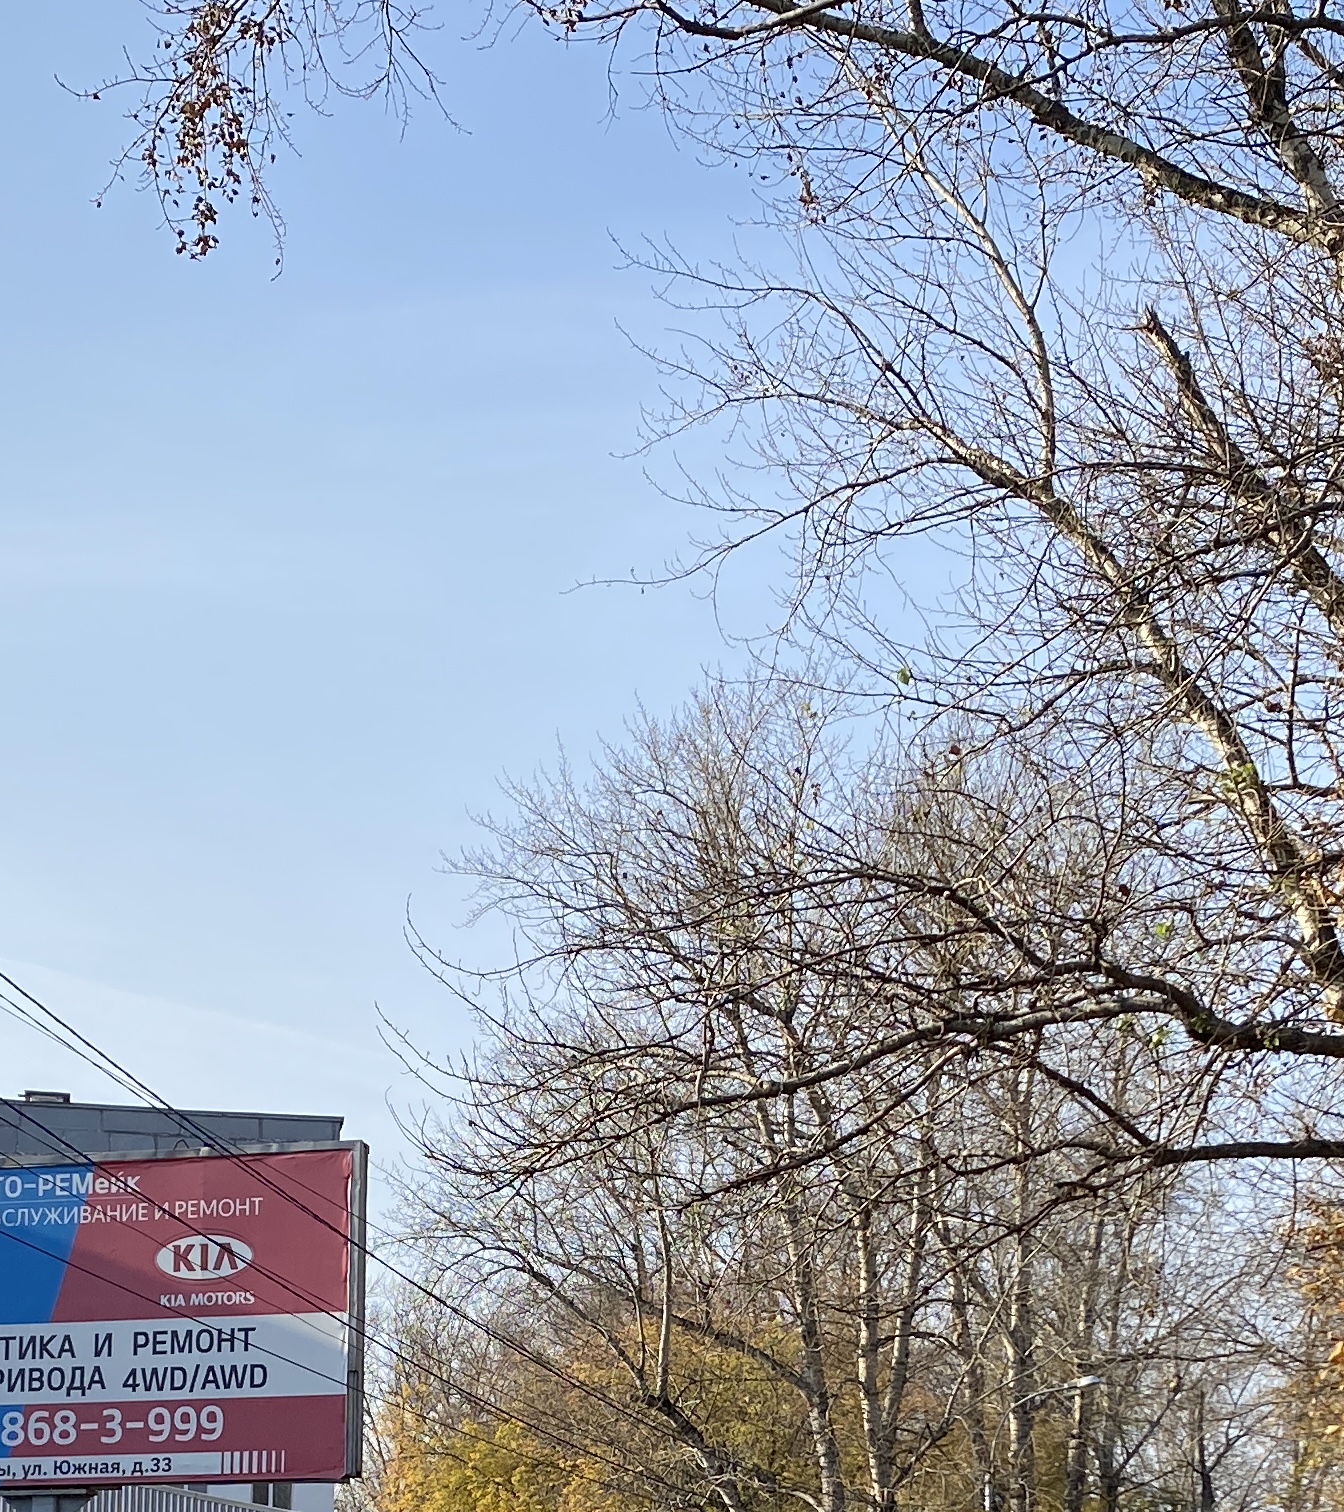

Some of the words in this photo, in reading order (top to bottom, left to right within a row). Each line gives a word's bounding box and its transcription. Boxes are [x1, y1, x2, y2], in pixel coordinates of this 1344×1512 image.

[154, 1201, 170, 1221] И
[175, 1197, 264, 1219] РЕМОНТ
[172, 1242, 239, 1273] KIA
[160, 1294, 186, 1308] KIA
[189, 1290, 256, 1307] MOTORS
[94, 1332, 113, 1358] И
[132, 1327, 257, 1357] РЕМОНТ
[122, 1363, 268, 1393] 4WD/AWD
[22, 1464, 48, 1480] ул.
[53, 1460, 126, 1477] Южная,
[131, 1457, 173, 1476] д.33
